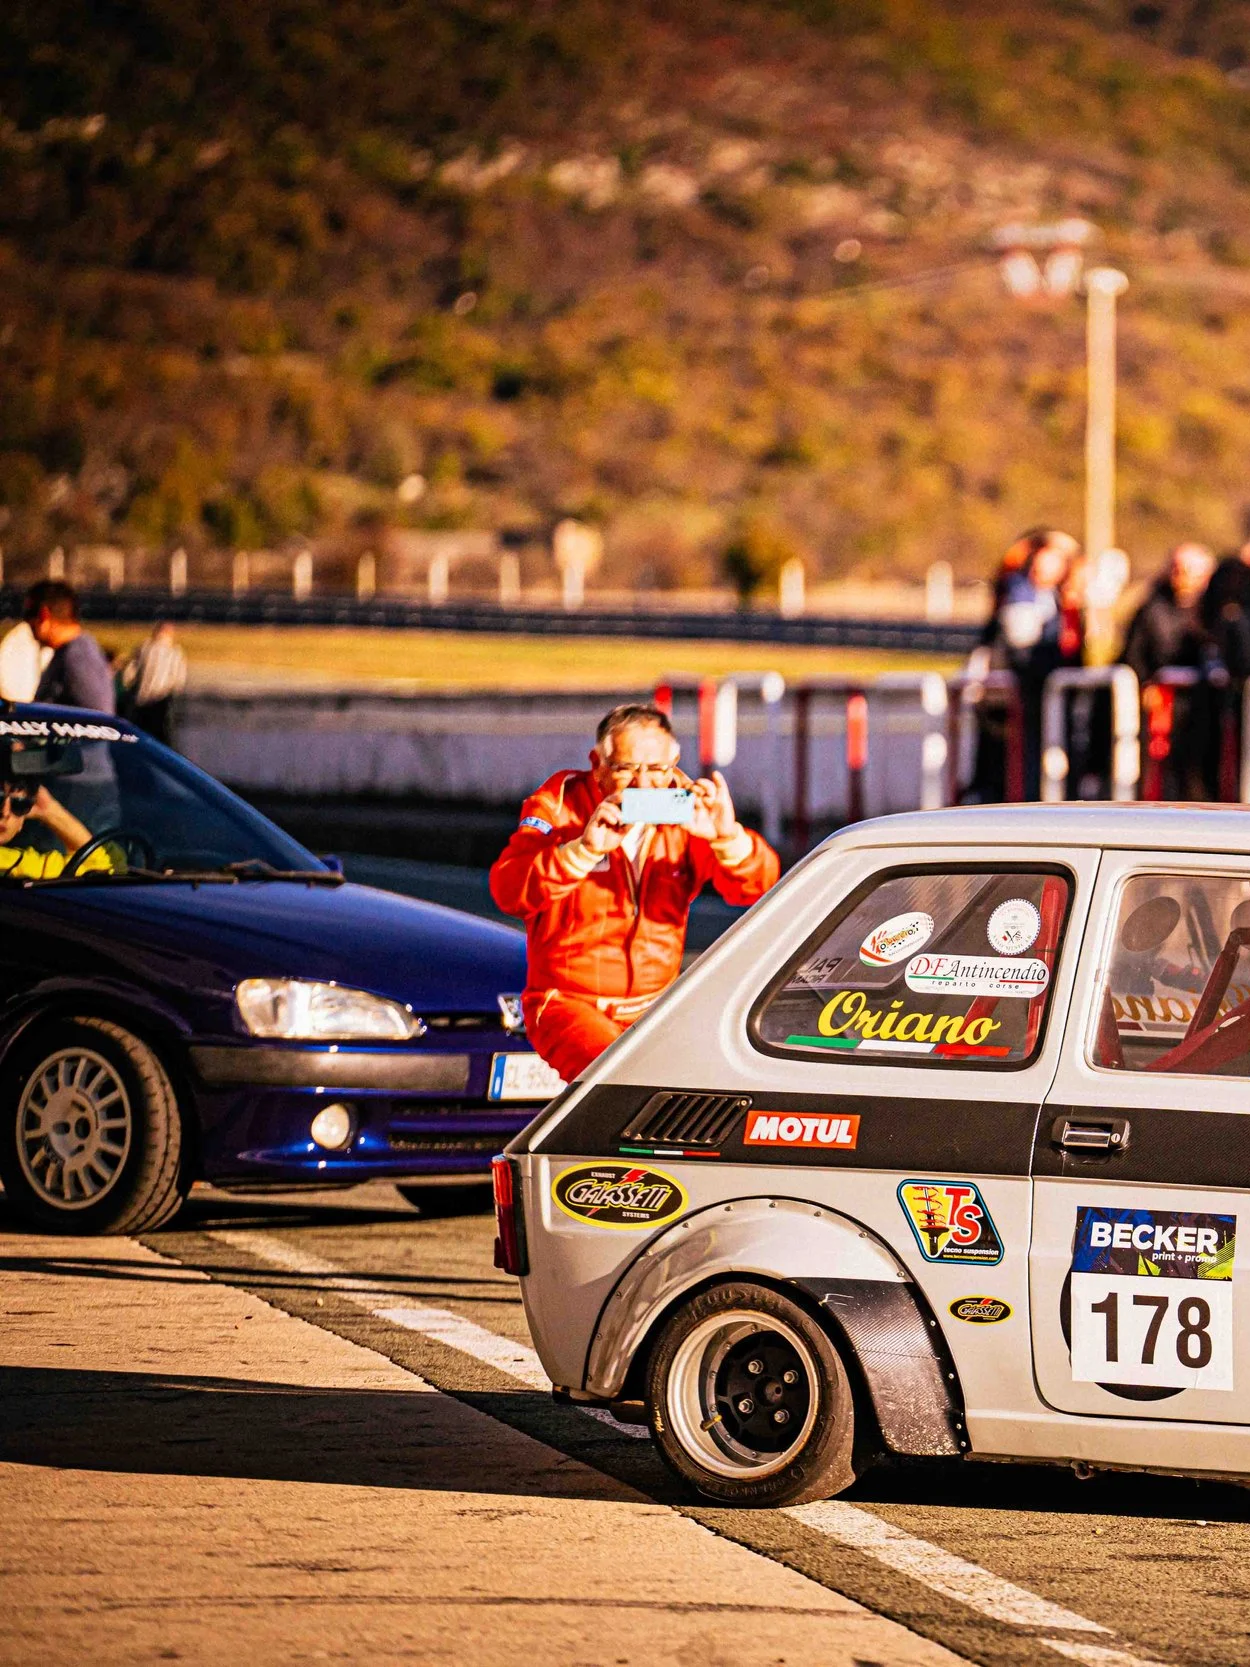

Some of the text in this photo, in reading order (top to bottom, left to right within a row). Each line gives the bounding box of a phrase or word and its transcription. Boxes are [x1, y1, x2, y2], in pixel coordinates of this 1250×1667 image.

[910, 957, 1046, 981] DF Antincendio
[931, 980, 976, 988] reparto
[817, 990, 1002, 1046] Oriano
[749, 1115, 853, 1144] MOTUL
[622, 1211, 650, 1219] SYSTEMS
[945, 1187, 982, 1244] TS
[1090, 1221, 1219, 1254] BECKER
[963, 1248, 999, 1256] suspension
[1152, 1251, 1175, 1262] print
[1185, 1254, 1217, 1264] promo
[1091, 1292, 1213, 1369] 178
